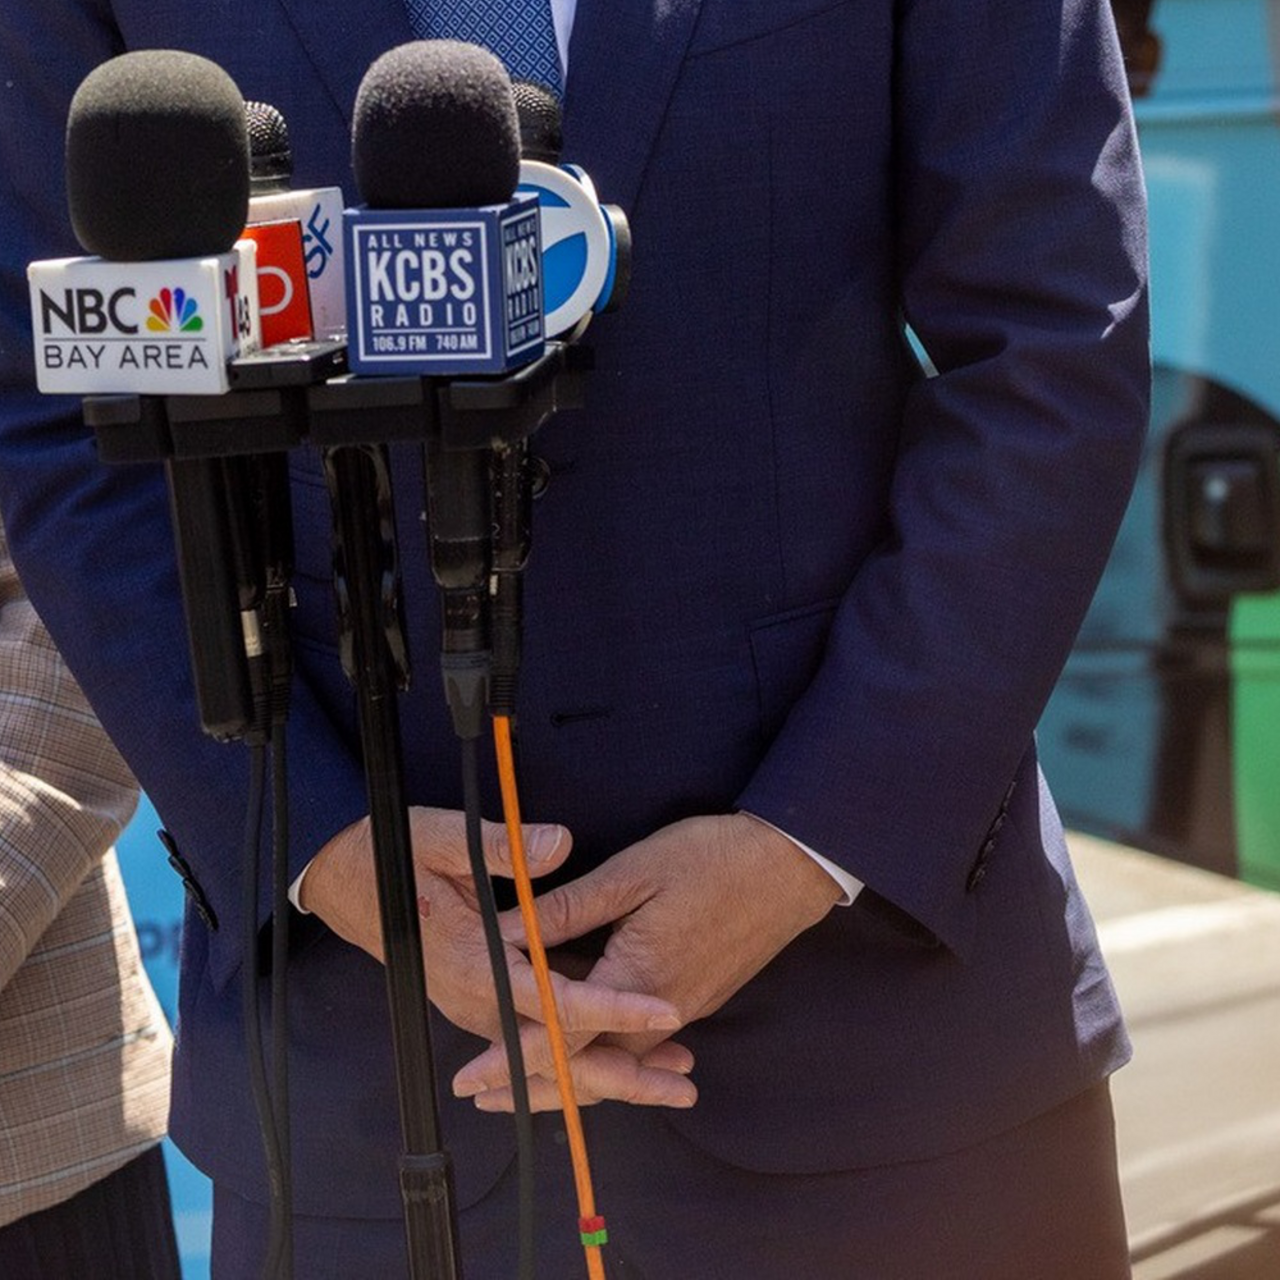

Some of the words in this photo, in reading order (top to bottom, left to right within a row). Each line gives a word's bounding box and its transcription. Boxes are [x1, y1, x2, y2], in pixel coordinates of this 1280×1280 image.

[368, 233, 403, 249] ALL
[414, 231, 473, 248] NEWS
[368, 248, 475, 302] KCBS
[39, 286, 139, 336] NBC
[371, 302, 477, 327] RADIO
[372, 335, 407, 352] 106.9
[408, 334, 427, 351] FM
[435, 334, 458, 351] 740
[459, 333, 478, 350] AM
[43, 344, 106, 369] BAY
[118, 344, 209, 369] AREA
